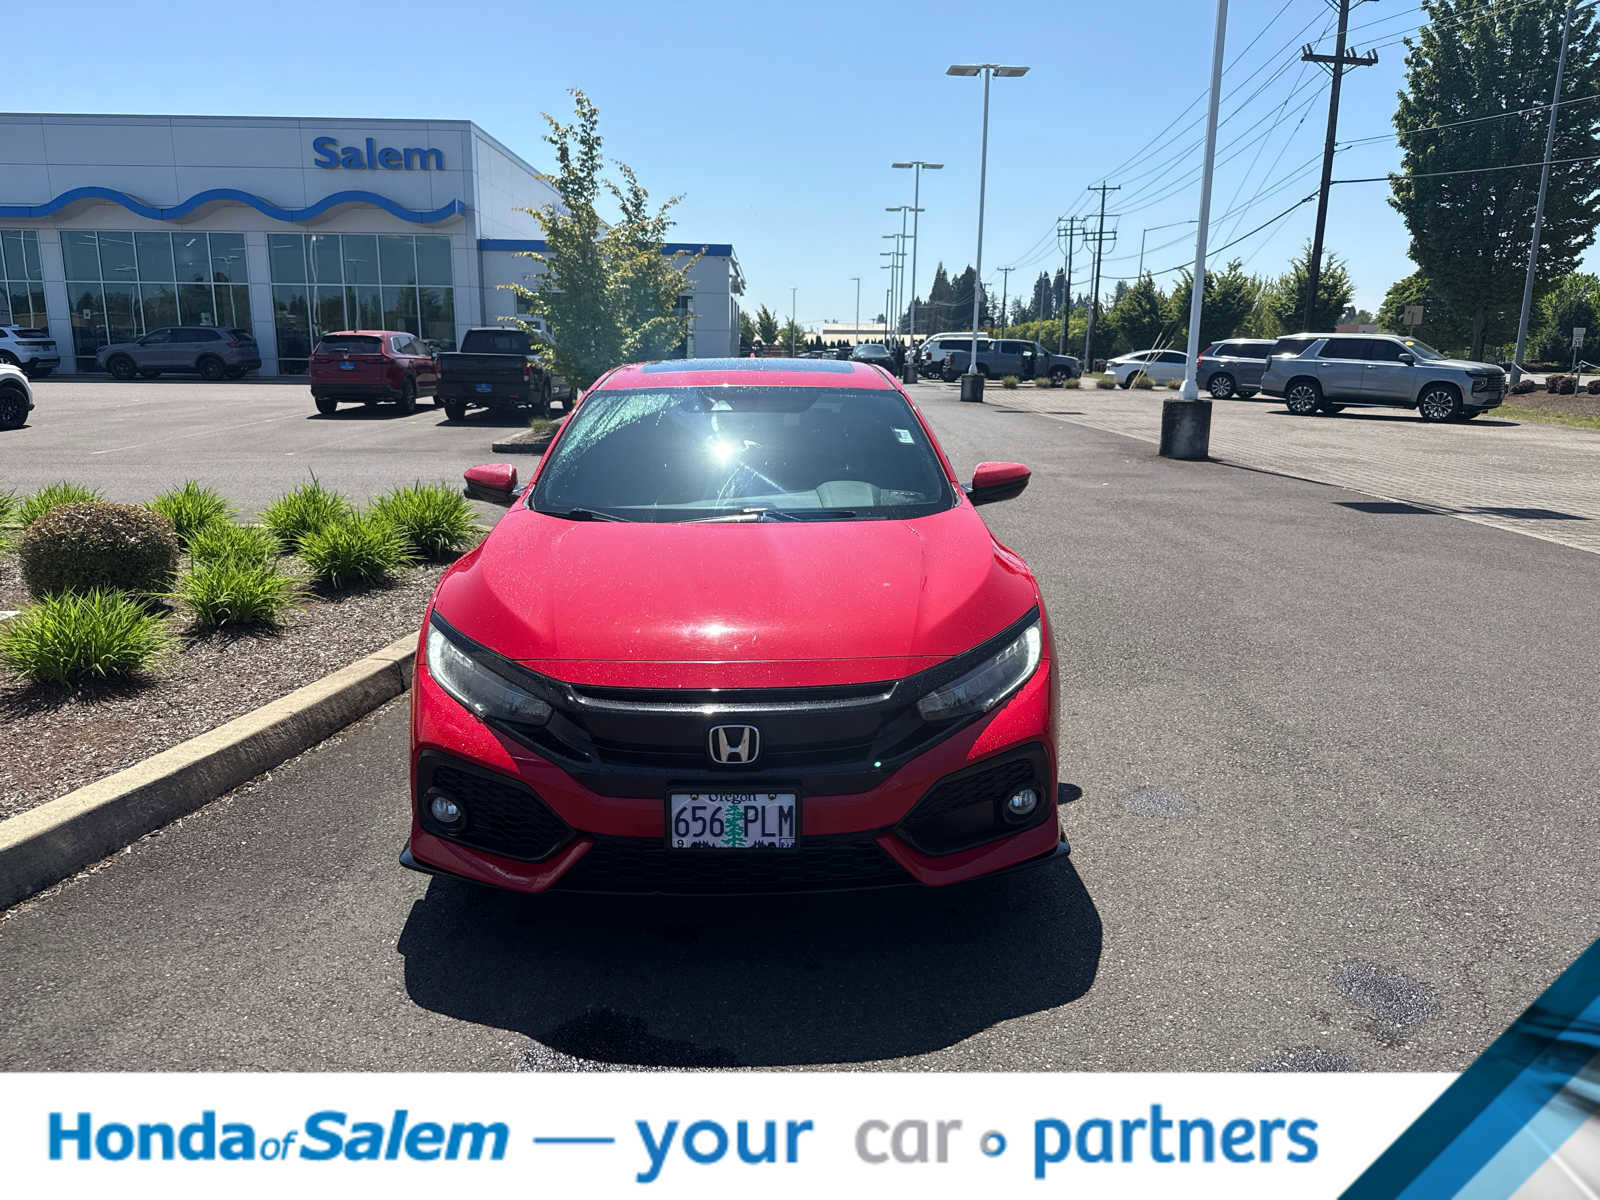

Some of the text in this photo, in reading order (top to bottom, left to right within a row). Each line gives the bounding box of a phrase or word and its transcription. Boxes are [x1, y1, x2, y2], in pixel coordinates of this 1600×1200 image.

[312, 136, 444, 170] Salem
[708, 792, 757, 804] Oregon
[674, 805, 794, 837] 656 PLM
